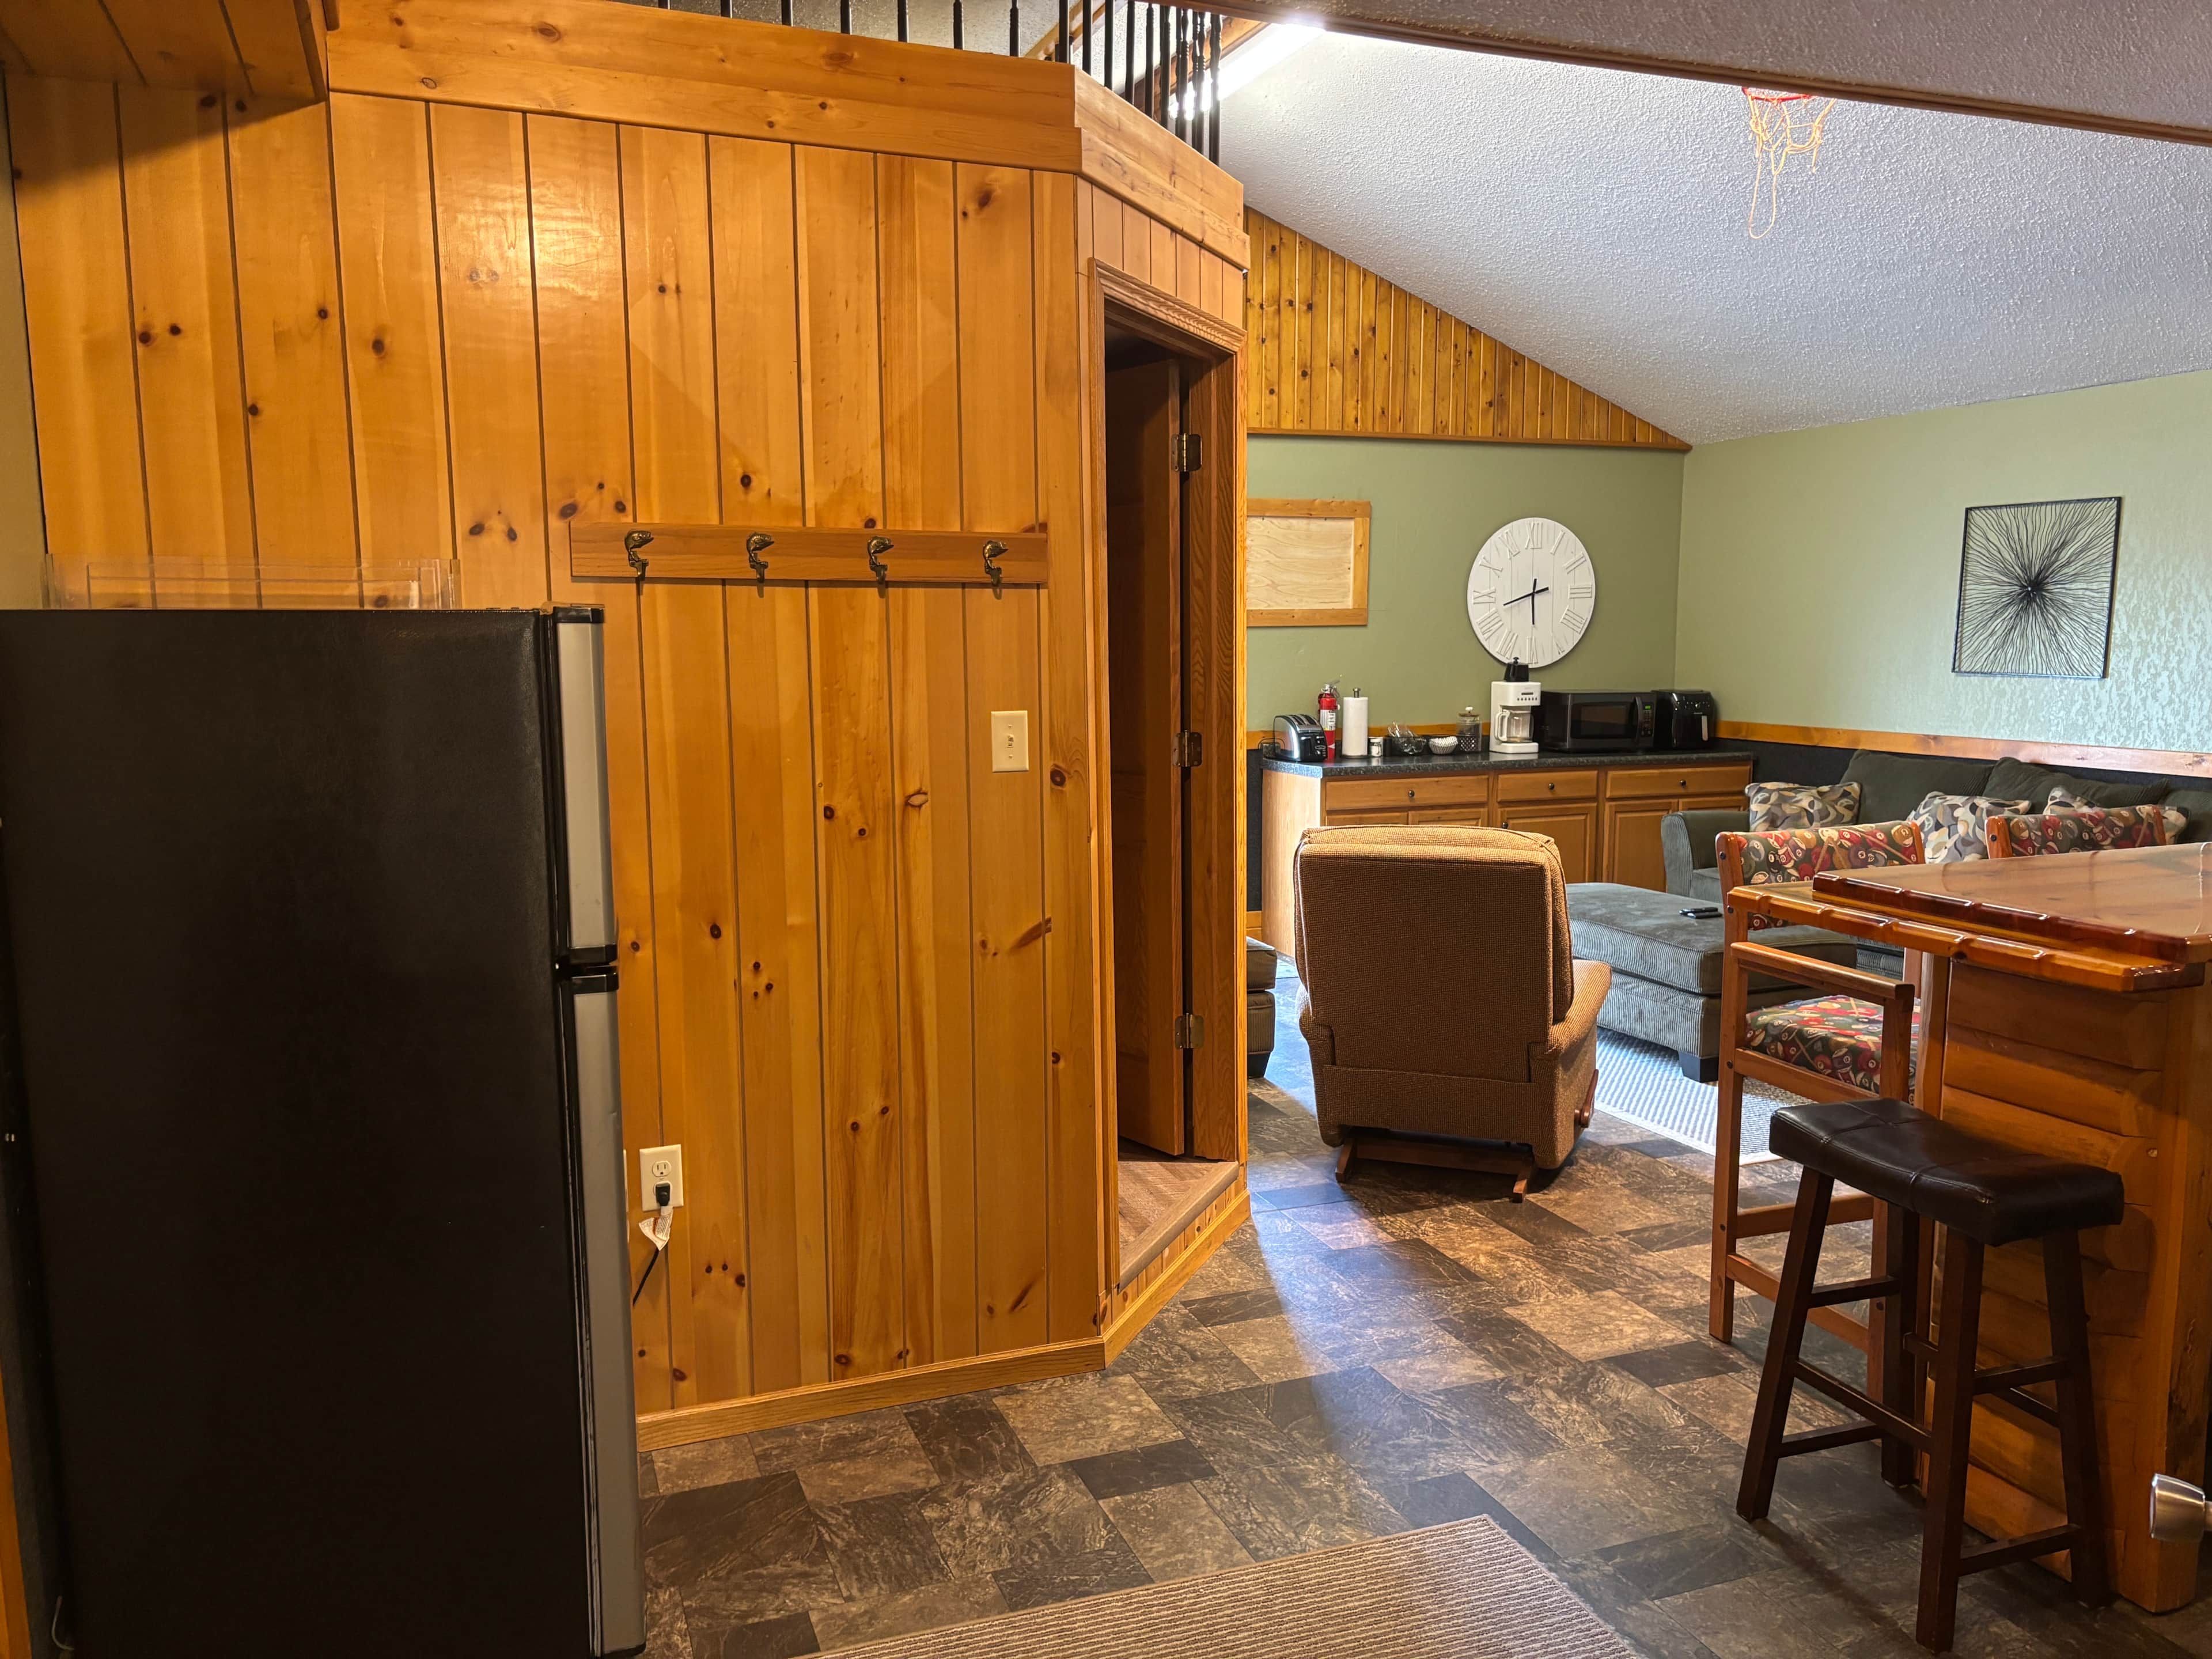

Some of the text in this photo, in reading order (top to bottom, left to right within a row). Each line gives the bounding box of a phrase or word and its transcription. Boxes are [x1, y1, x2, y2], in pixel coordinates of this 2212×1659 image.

[1498, 529, 1521, 560] XI
[1525, 521, 1543, 550] XII
[1550, 529, 1566, 555] I
[1479, 555, 1503, 578] X
[1564, 552, 1586, 574] II
[1472, 586, 1497, 604] IX
[1569, 583, 1593, 599] III
[1477, 608, 1504, 641] VIII
[1497, 629, 1518, 659] VII
[1526, 635, 1539, 664] VI
